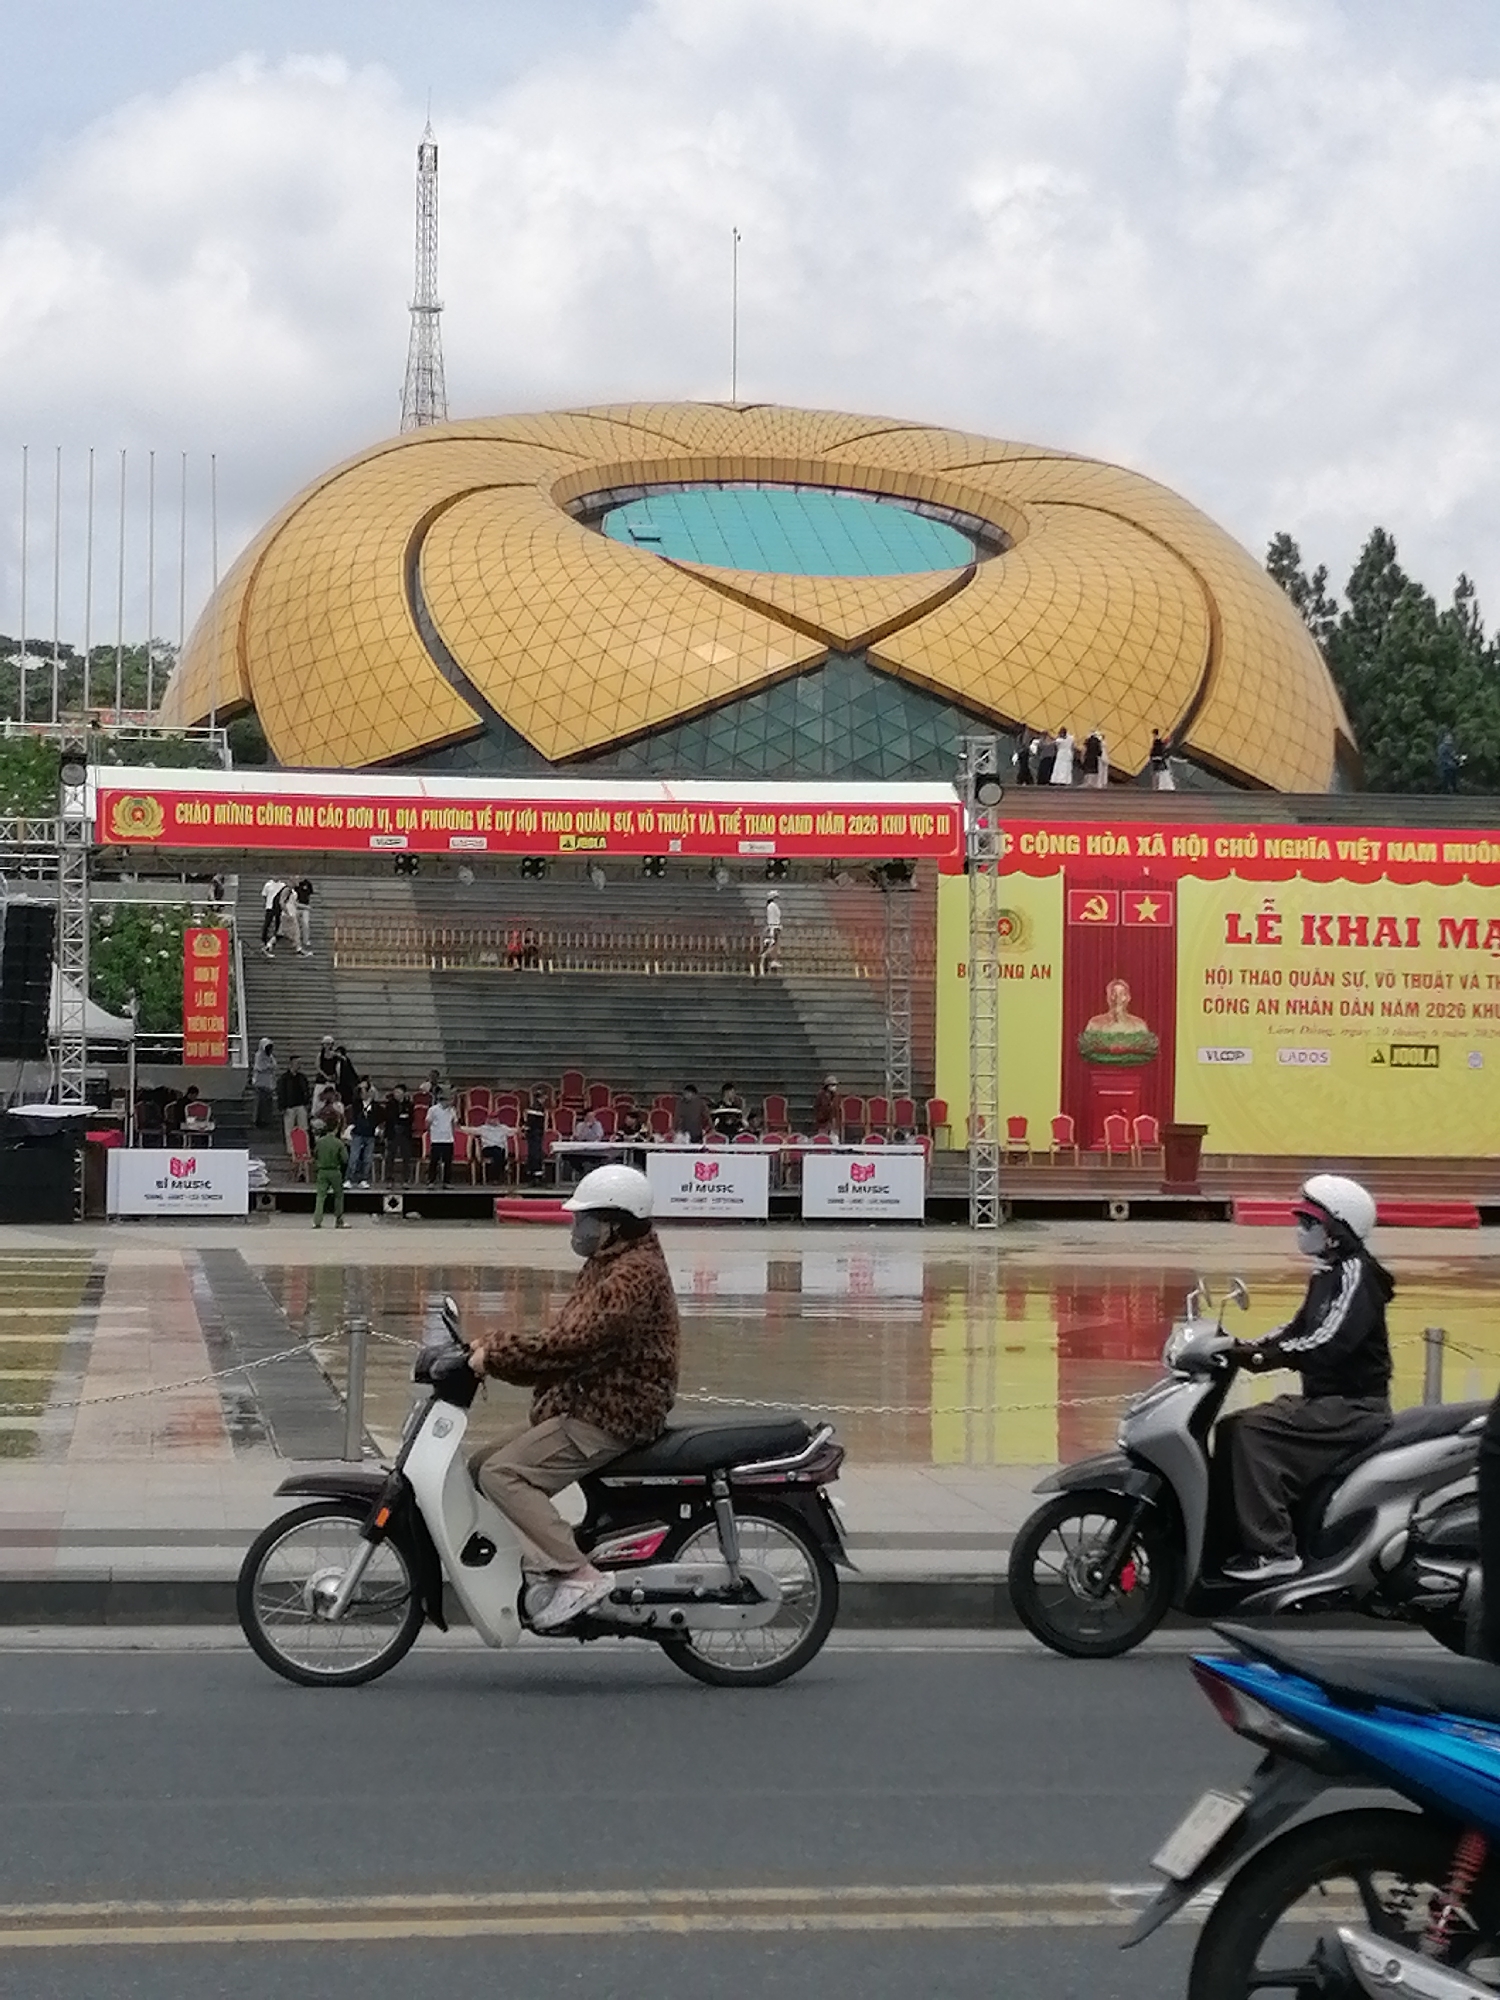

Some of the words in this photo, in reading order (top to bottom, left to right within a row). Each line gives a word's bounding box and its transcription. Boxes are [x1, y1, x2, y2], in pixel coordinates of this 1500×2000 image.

[257, 802, 293, 827] CÔNG
[296, 804, 314, 827] AN
[317, 803, 344, 829] CÁC
[516, 807, 538, 838] HỘI
[541, 810, 573, 833] THAO
[575, 807, 611, 834] QUÂN
[657, 807, 696, 839] THUẬT
[745, 813, 777, 836] THAO
[816, 810, 846, 836] NĂM
[848, 813, 878, 836] 2026
[881, 813, 907, 836] KHU
[909, 813, 934, 841] VỰC
[1019, 830, 1081, 859] CỘNG
[1086, 830, 1130, 856] HÒA
[1136, 832, 1166, 858] XÃ
[1172, 833, 1209, 862] HỘI
[1214, 831, 1259, 859] CHỦ
[1264, 836, 1331, 861] NGHĨA
[1336, 837, 1382, 866] VIỆT
[1387, 841, 1438, 863] NAM
[1224, 897, 1283, 946] LỄ
[1301, 914, 1421, 949] KHAI
[1030, 963, 1052, 981] AN
[1204, 965, 1233, 990] HỘI
[1239, 968, 1283, 987] THAO
[1288, 966, 1336, 988] QUÂN
[1401, 969, 1454, 994] THUẬT
[1202, 994, 1250, 1015] CÔNG
[1255, 998, 1280, 1016] AN
[1285, 995, 1334, 1016] NHÂN
[1380, 997, 1420, 1018] NĂM
[1425, 1001, 1466, 1019] 2026
[1278, 1051, 1328, 1064] LADOS
[1391, 1046, 1439, 1067] JOOLA
